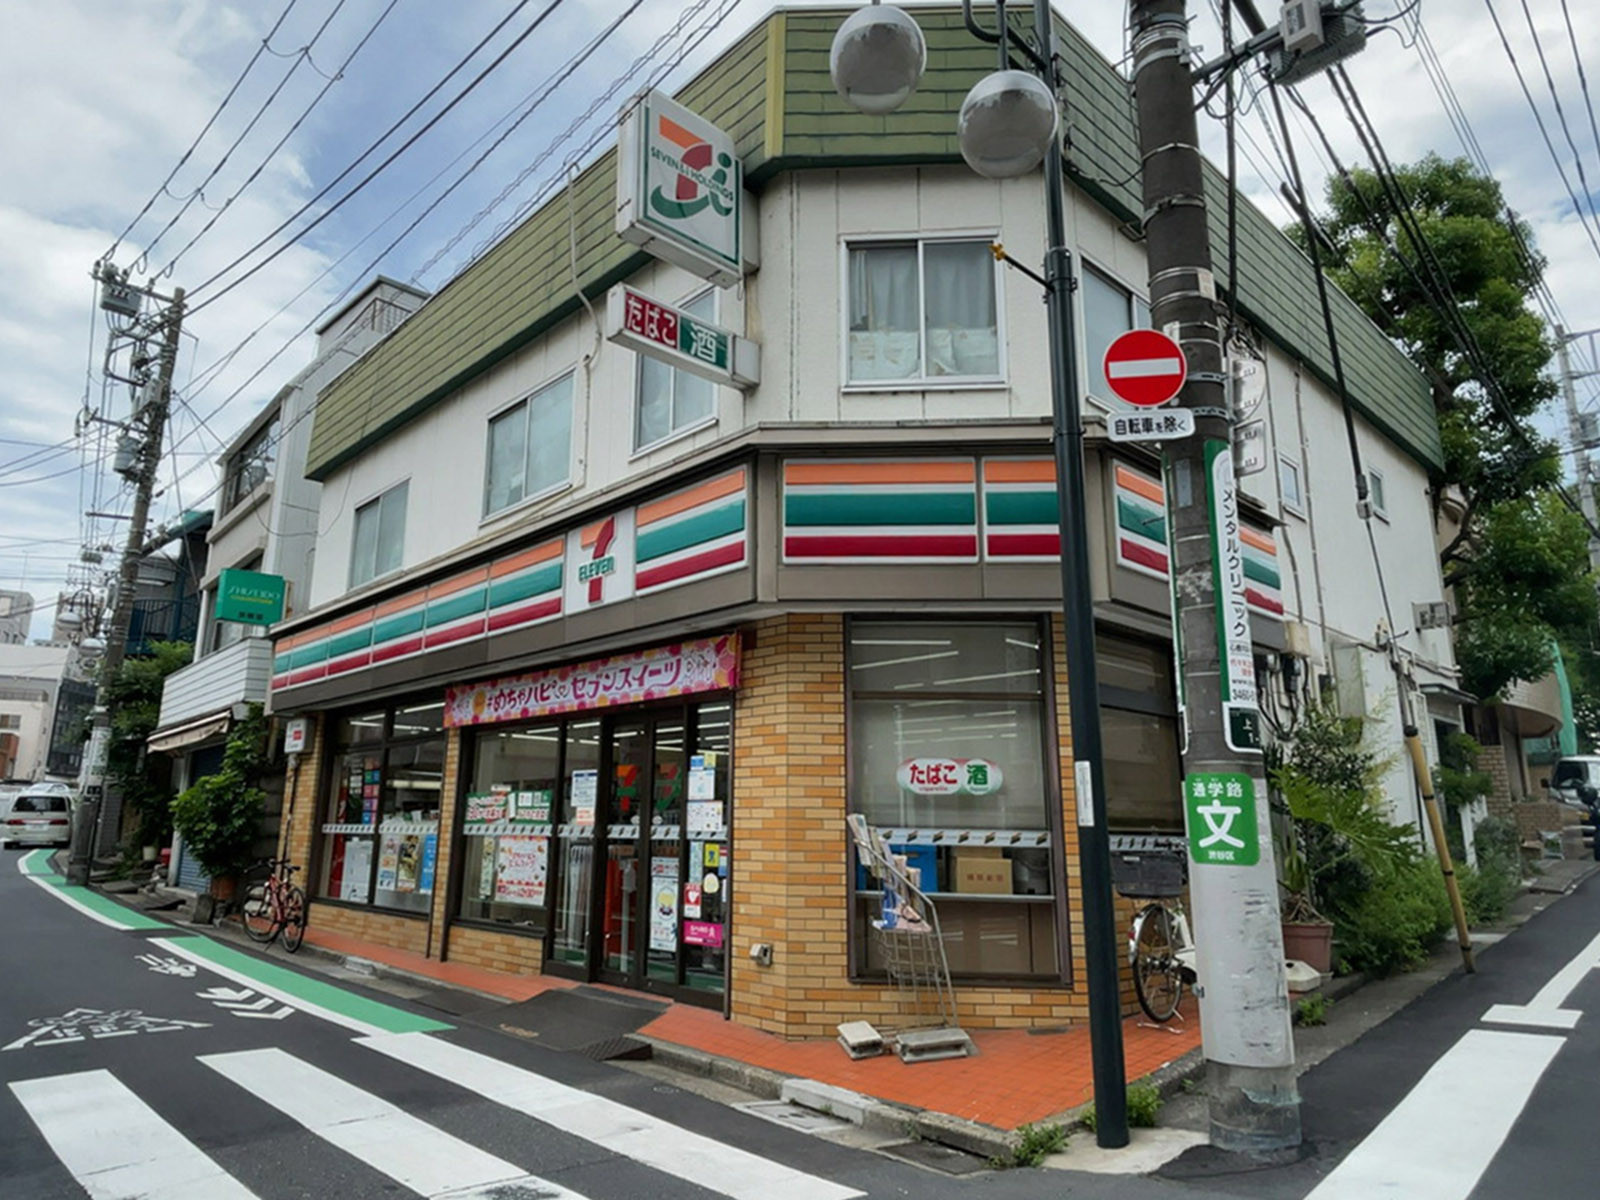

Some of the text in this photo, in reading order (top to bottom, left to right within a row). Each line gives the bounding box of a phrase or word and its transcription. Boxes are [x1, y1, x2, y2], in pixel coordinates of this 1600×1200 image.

[626, 296, 718, 364] たばこ 酒
[1114, 415, 1187, 436] 自転車を除く
[1222, 488, 1247, 638] メンタルクリニック
[570, 657, 683, 700] セブンスイーツ
[909, 763, 989, 786] たばこ 酒
[1192, 782, 1243, 798] 通学路
[1196, 799, 1245, 849] 文
